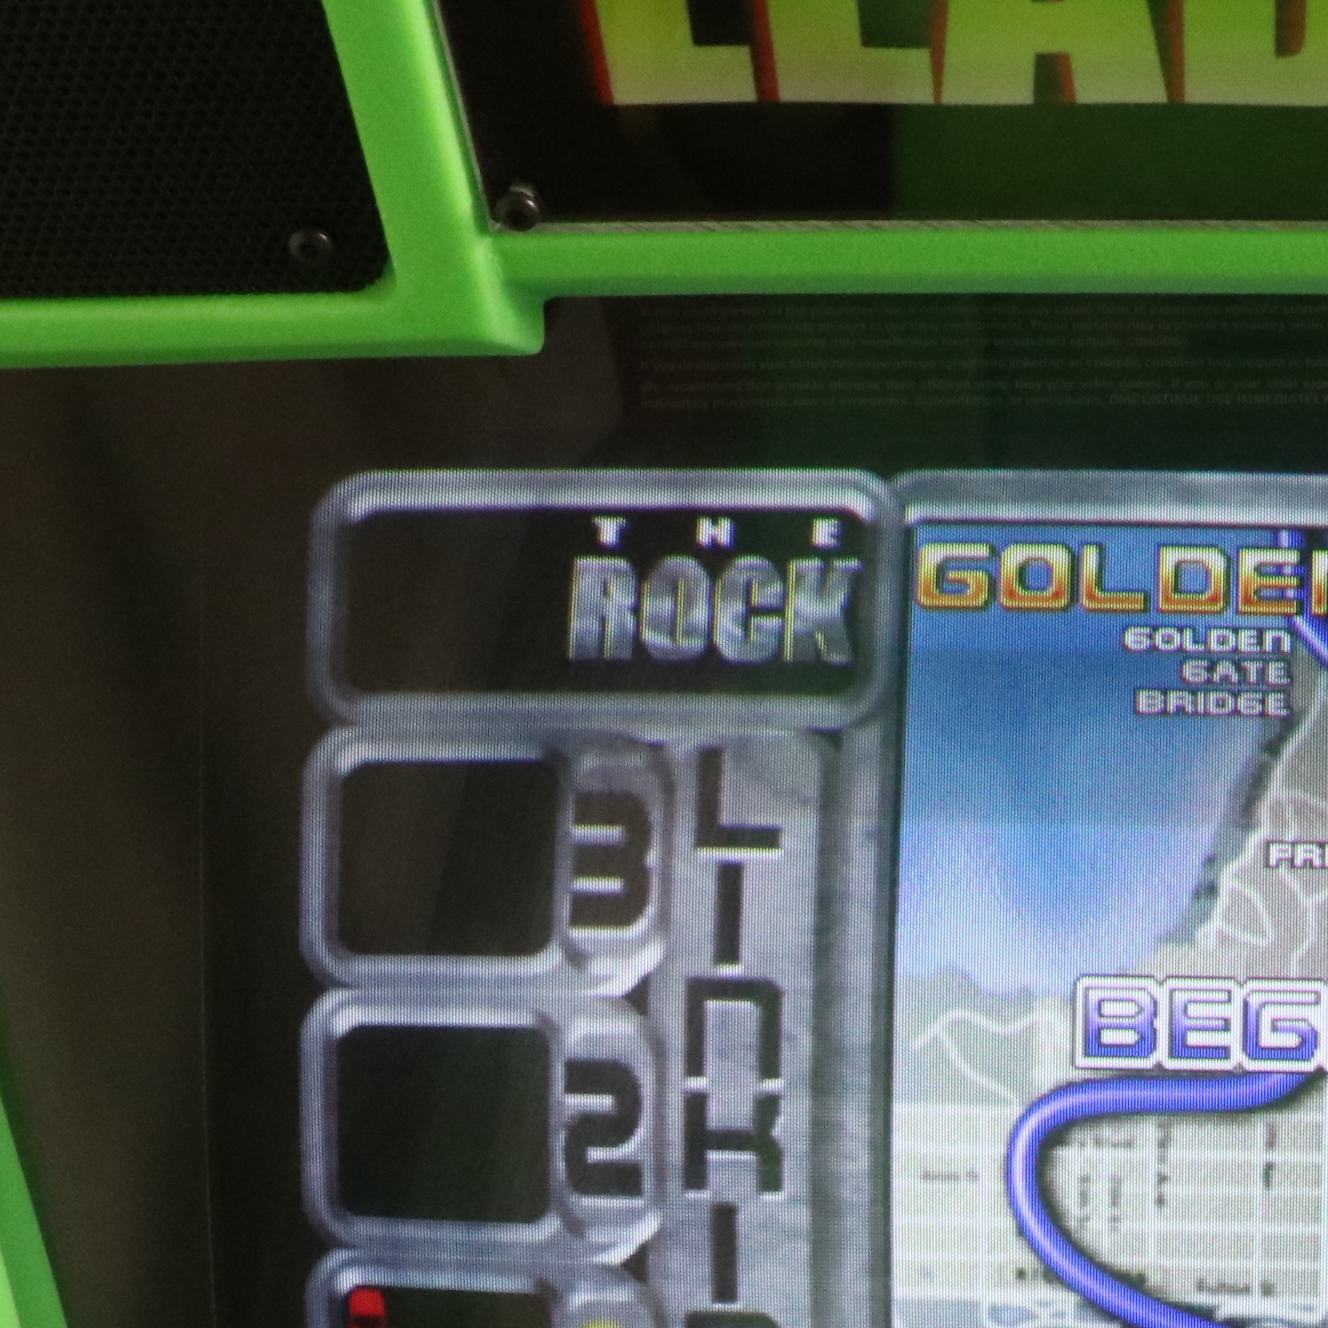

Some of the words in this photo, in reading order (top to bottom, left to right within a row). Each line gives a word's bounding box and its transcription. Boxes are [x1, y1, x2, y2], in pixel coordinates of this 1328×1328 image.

[593, 516, 840, 548] THE
[567, 555, 861, 666] ROCK
[1123, 626, 1293, 654] GOLDEN
[1181, 658, 1292, 687] GATE
[1134, 689, 1293, 717] BRIDGE
[567, 790, 653, 931] 3
[564, 1059, 645, 1197] 2
